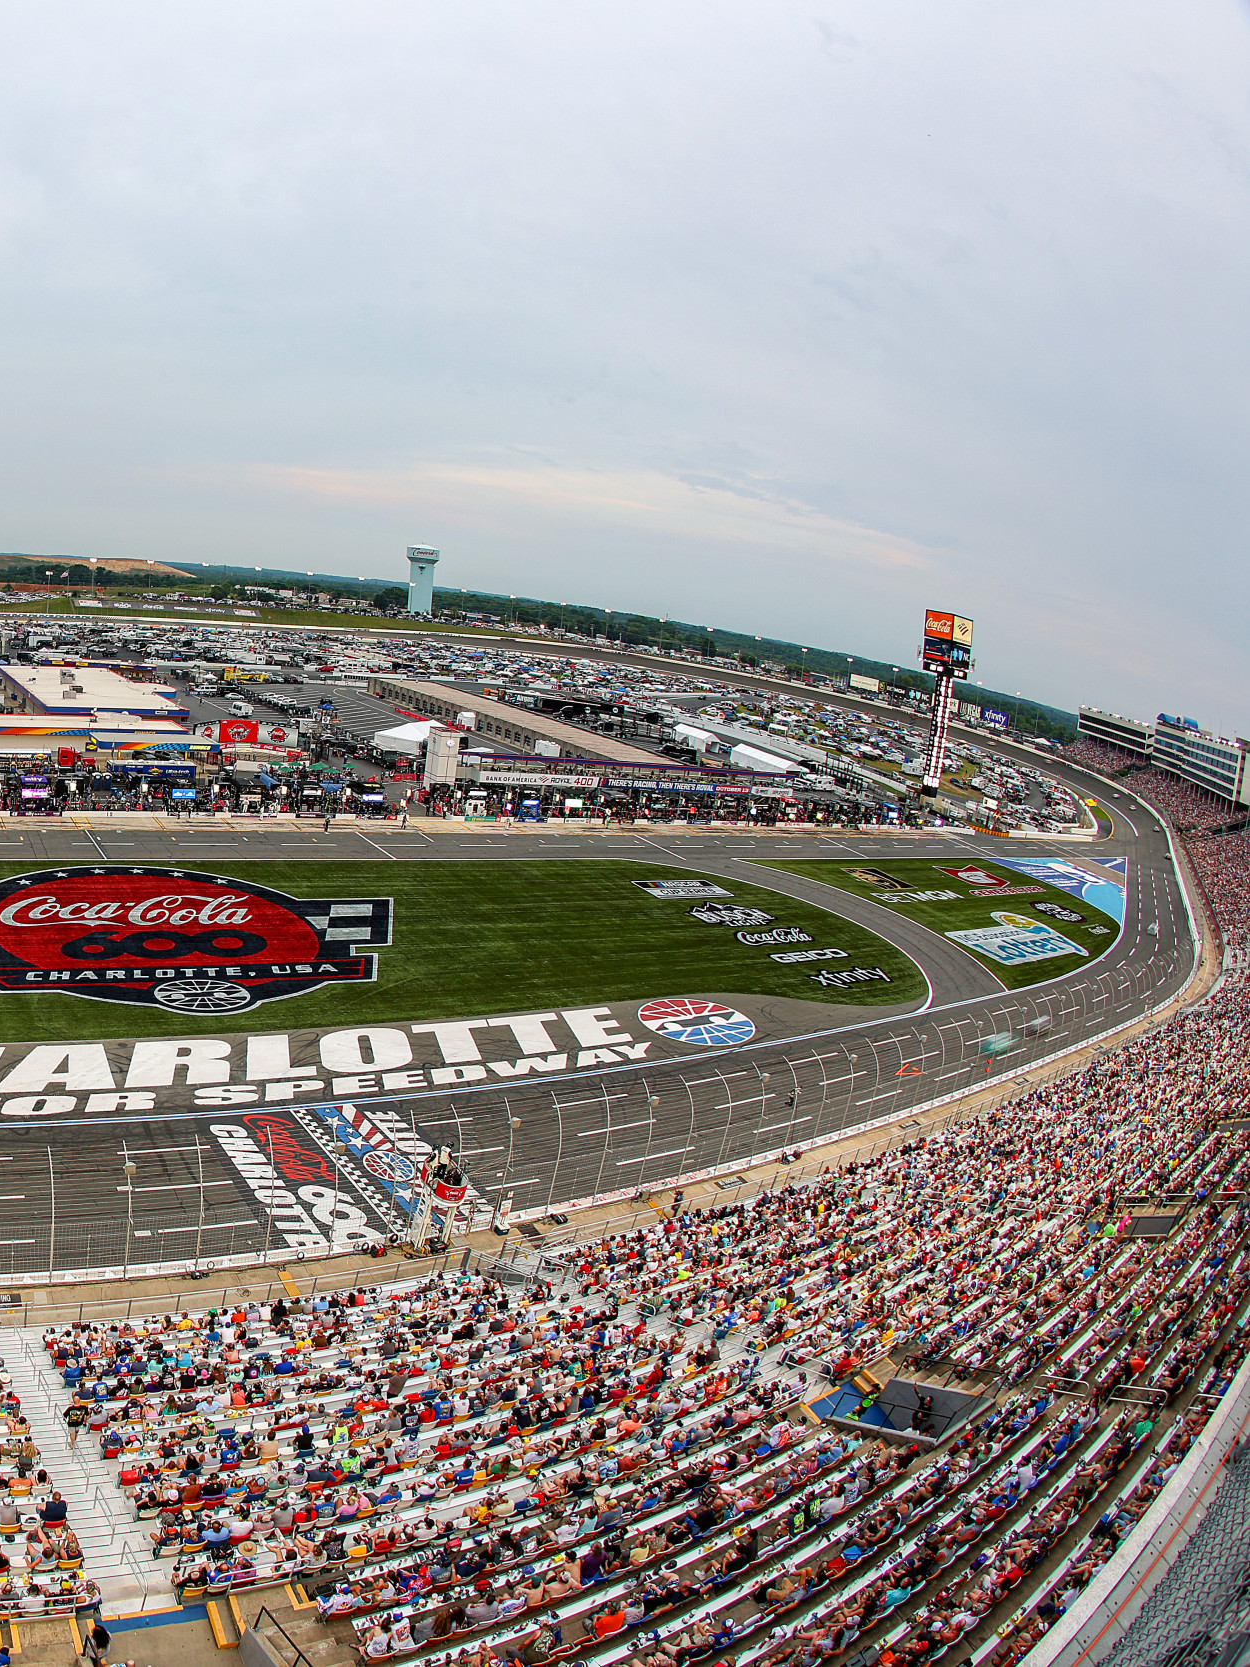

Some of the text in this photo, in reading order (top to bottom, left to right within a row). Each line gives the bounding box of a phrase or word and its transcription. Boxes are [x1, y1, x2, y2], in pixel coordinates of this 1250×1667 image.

[574, 777, 593, 786] 400
[608, 778, 633, 788] THERE'S
[633, 780, 657, 790] RACING,
[658, 781, 673, 790] THEN
[674, 783, 696, 791] THERE'S
[870, 889, 965, 904] BETMGM
[692, 907, 775, 924] BUSCH
[59, 929, 268, 961] 600
[737, 928, 812, 946] Coca-Cola
[770, 949, 850, 964] GEICO
[972, 933, 1080, 962] Lottery
[25, 963, 339, 982] CHARLOTTE, USA
[810, 966, 892, 989] xfinity
[193, 1041, 652, 1107] SPEEDWAY
